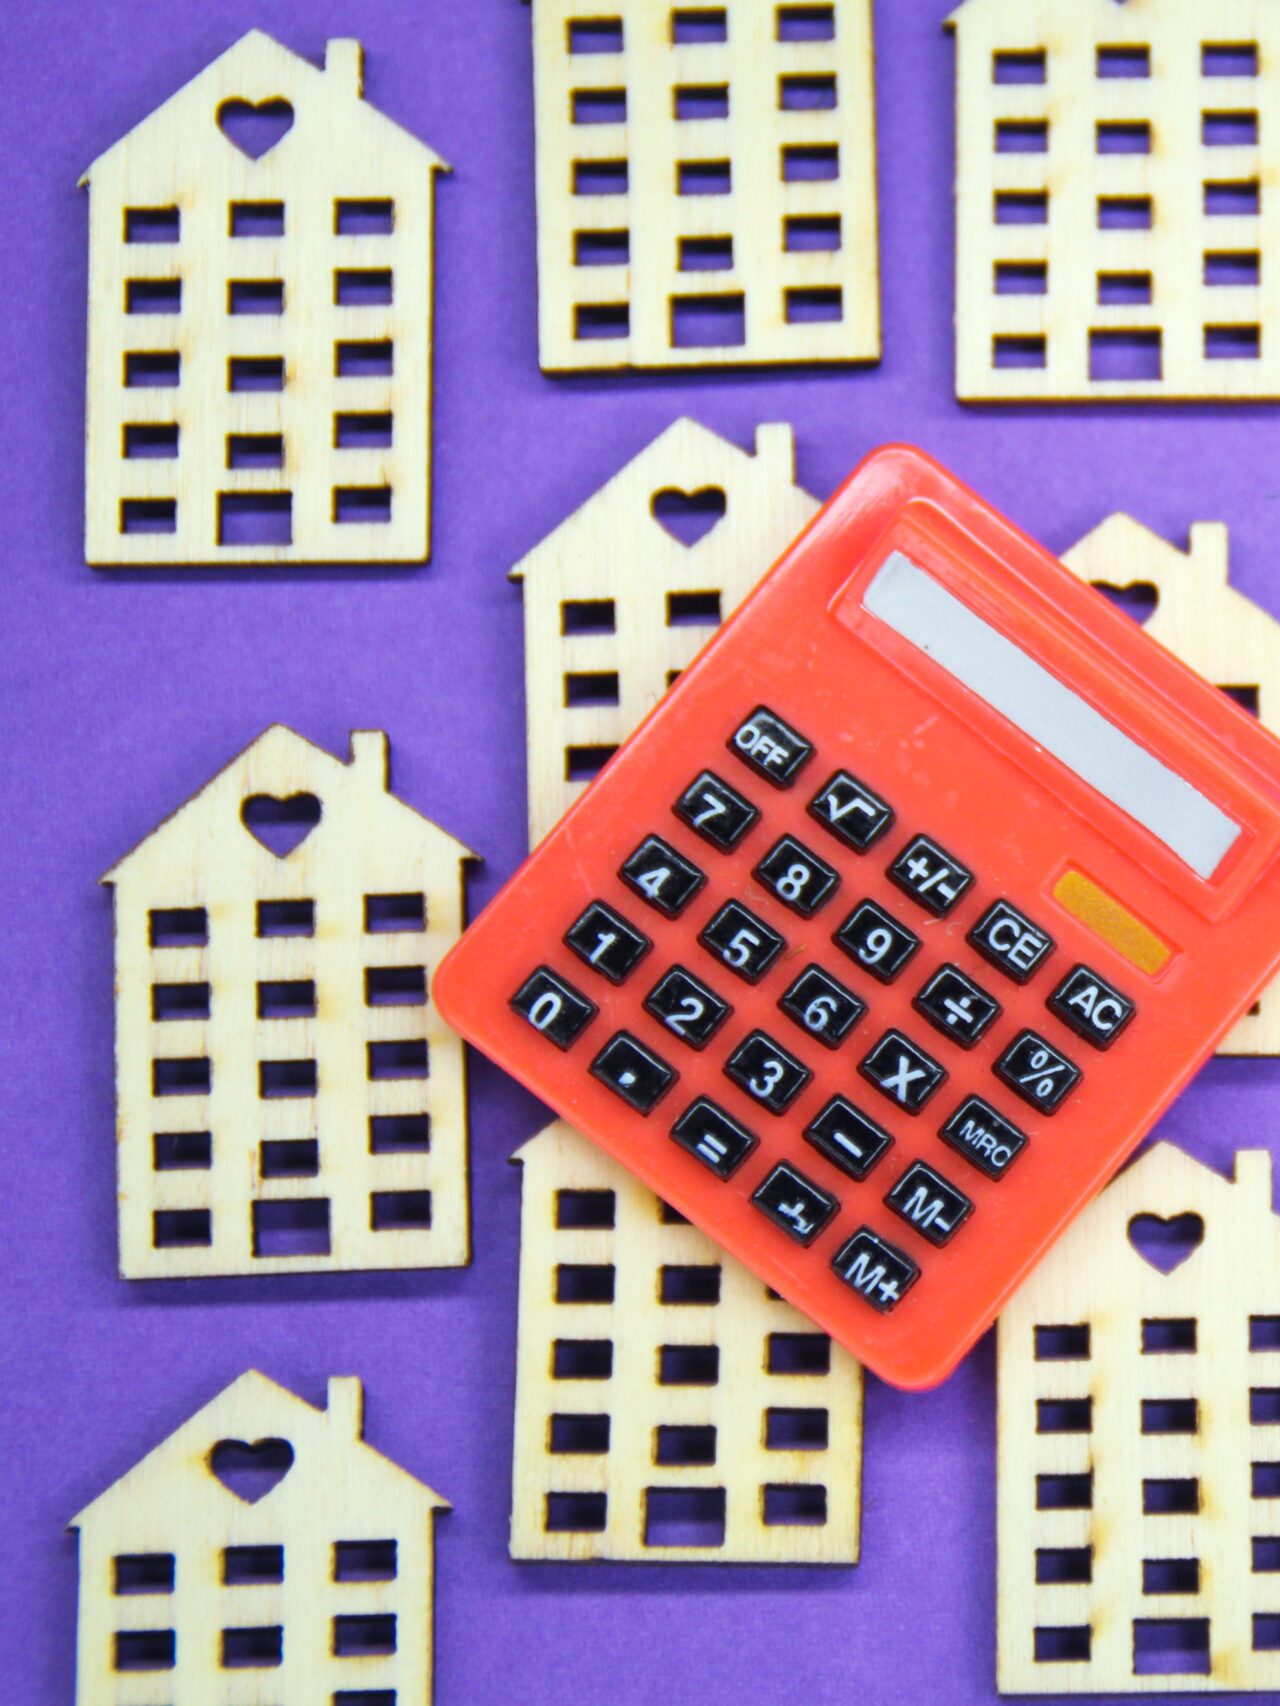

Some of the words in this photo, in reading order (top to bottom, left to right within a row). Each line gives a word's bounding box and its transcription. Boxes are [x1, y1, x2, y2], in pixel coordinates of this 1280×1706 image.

[637, 867, 671, 897] 4
[723, 929, 760, 967] 5
[803, 996, 837, 1031] 6
[694, 793, 727, 827] 7
[776, 864, 810, 900] 8
[858, 929, 892, 964] 9
[1019, 1050, 1065, 1097] %
[735, 725, 788, 766] OFF
[988, 918, 1041, 971] CE
[1068, 985, 1122, 1030] AC
[528, 993, 561, 1031] 0
[844, 1252, 899, 1302] M+
[589, 932, 617, 964] 1
[665, 997, 704, 1035] 2
[750, 1061, 784, 1097] 3
[902, 1186, 951, 1232] M-
